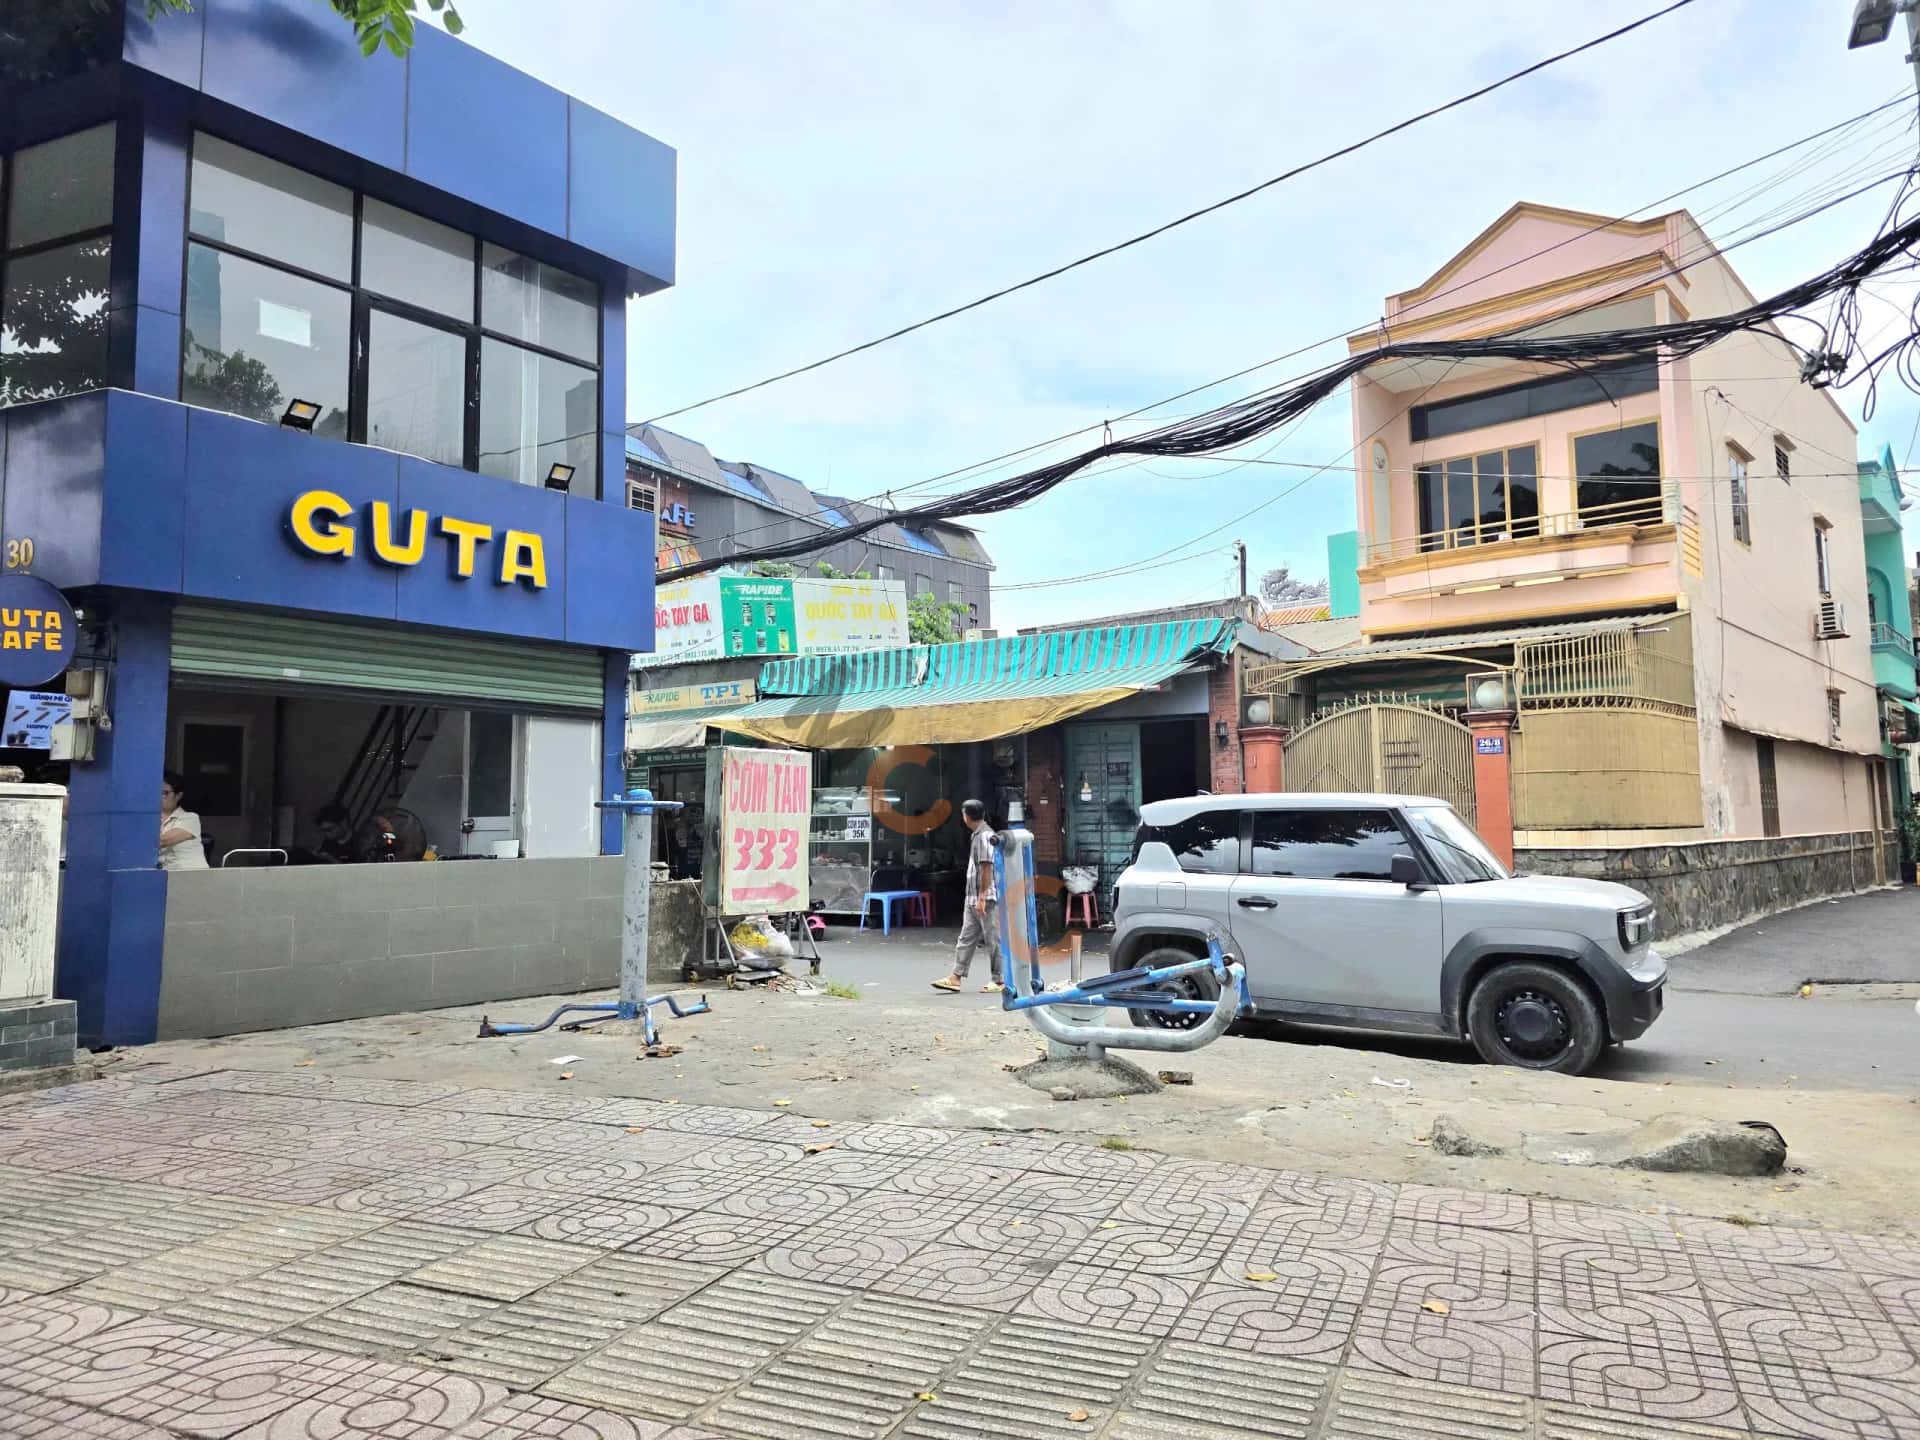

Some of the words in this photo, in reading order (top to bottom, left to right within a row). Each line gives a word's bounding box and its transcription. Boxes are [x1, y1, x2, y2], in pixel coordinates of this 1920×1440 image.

[290, 490, 548, 589] GUTA
[6, 537, 35, 569] 30
[738, 584, 784, 595] RAPIDE
[1, 608, 62, 630] UTA
[671, 606, 690, 626] TAY
[693, 602, 711, 623] GA
[0, 630, 63, 651] AFE
[642, 690, 680, 705] RAPIDE
[699, 683, 743, 699] TPI
[734, 828, 799, 870] 333
